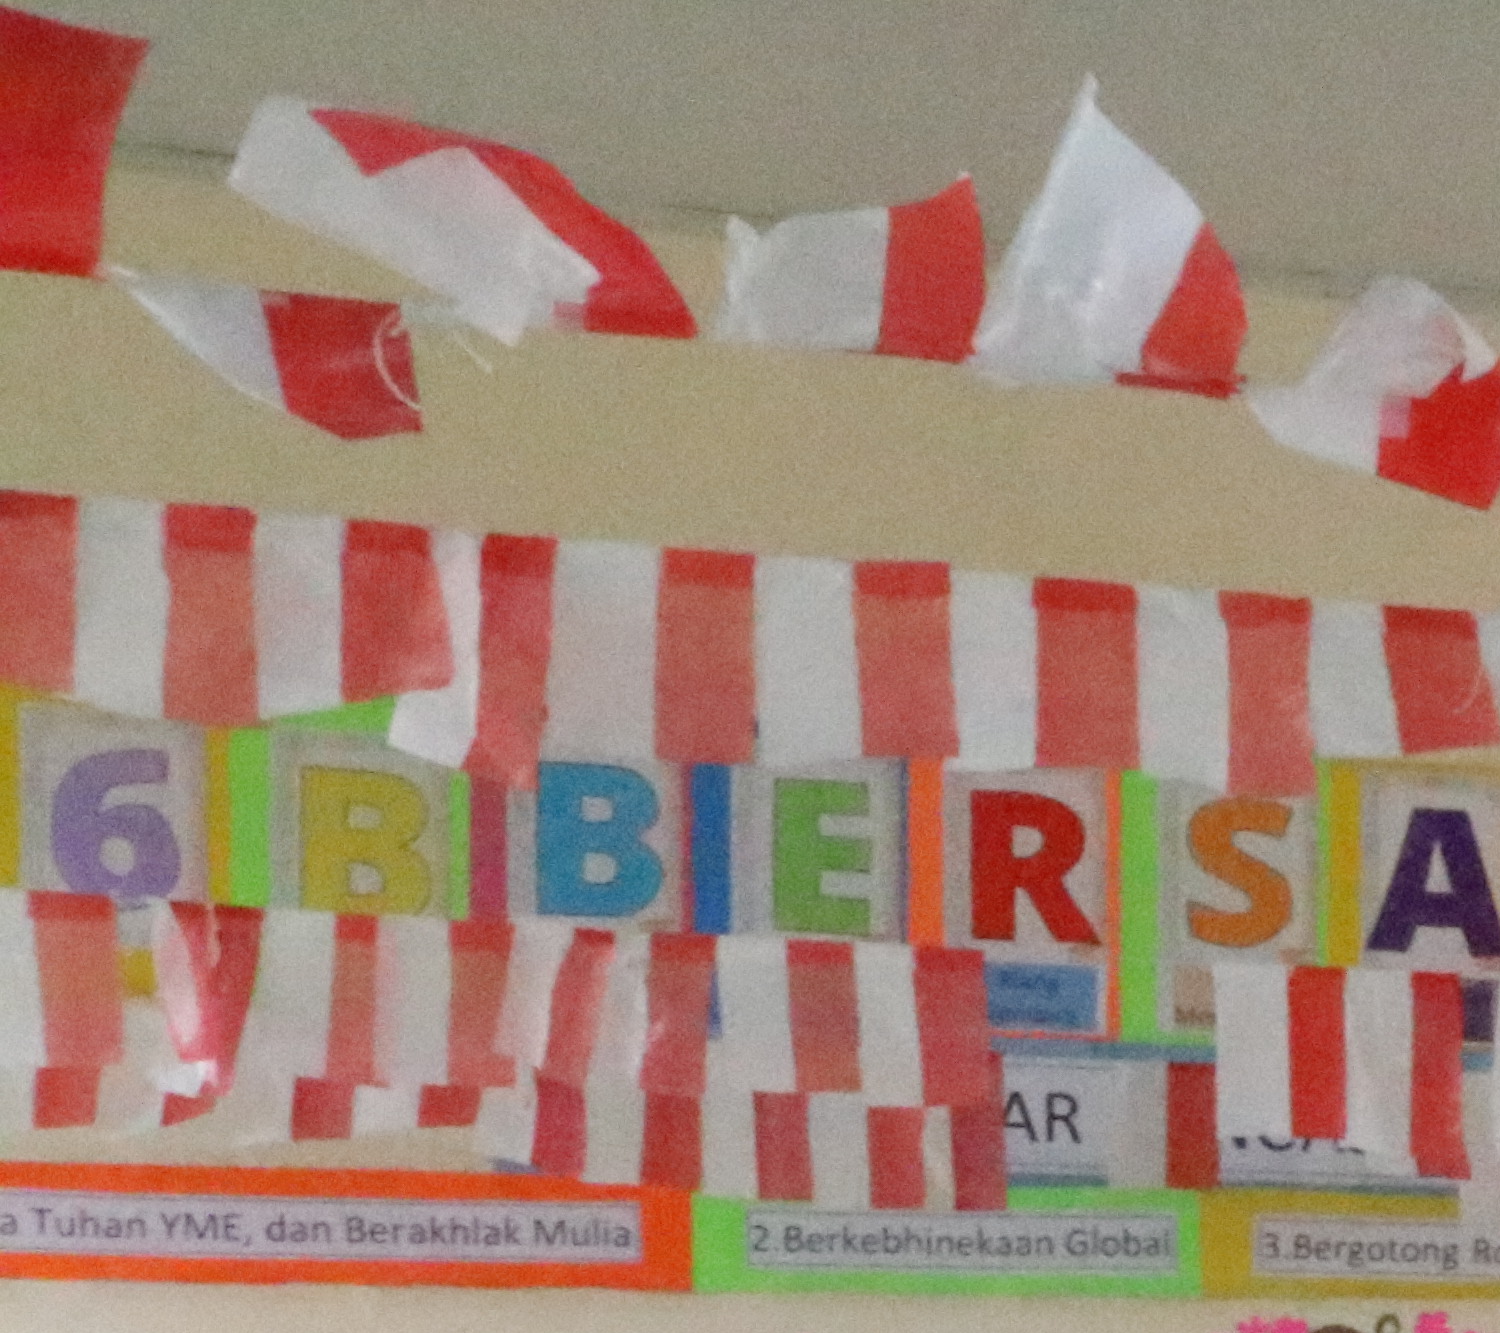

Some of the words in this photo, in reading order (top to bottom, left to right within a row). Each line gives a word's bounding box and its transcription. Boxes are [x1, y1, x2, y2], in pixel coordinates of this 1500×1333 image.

[32, 1206, 147, 1242] Tuhan
[158, 1213, 252, 1248] YME,
[264, 1212, 331, 1244] dan
[345, 1217, 522, 1246] Berakhlak
[533, 1219, 632, 1249] Mulia
[1064, 1226, 1172, 1259] Global
[1261, 1233, 1459, 1271] 3.Bergotong
